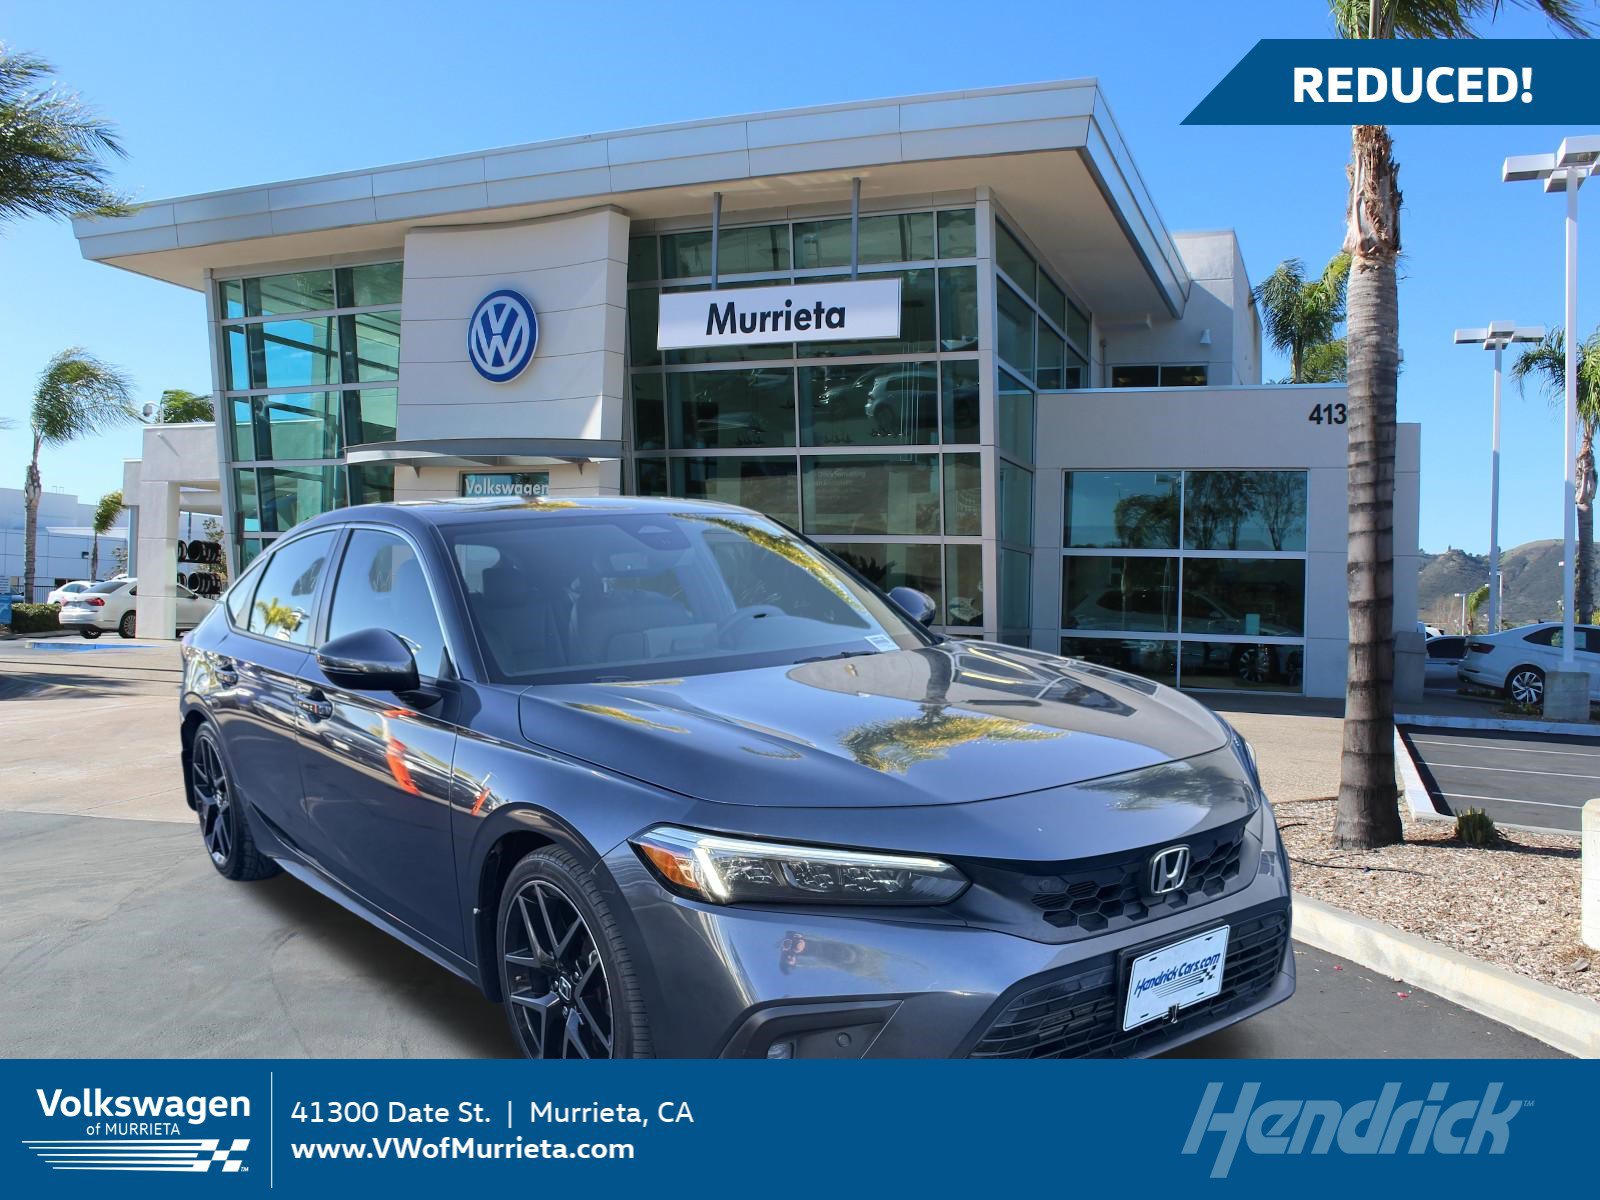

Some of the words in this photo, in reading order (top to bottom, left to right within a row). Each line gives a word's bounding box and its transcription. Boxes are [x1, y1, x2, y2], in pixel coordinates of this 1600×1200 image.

[705, 298, 846, 336] Murrieta
[1308, 403, 1347, 425] 413
[465, 477, 549, 496] Volkswagen
[1134, 966, 1179, 998] Hendrick
[1178, 953, 1221, 977] Cars.com
